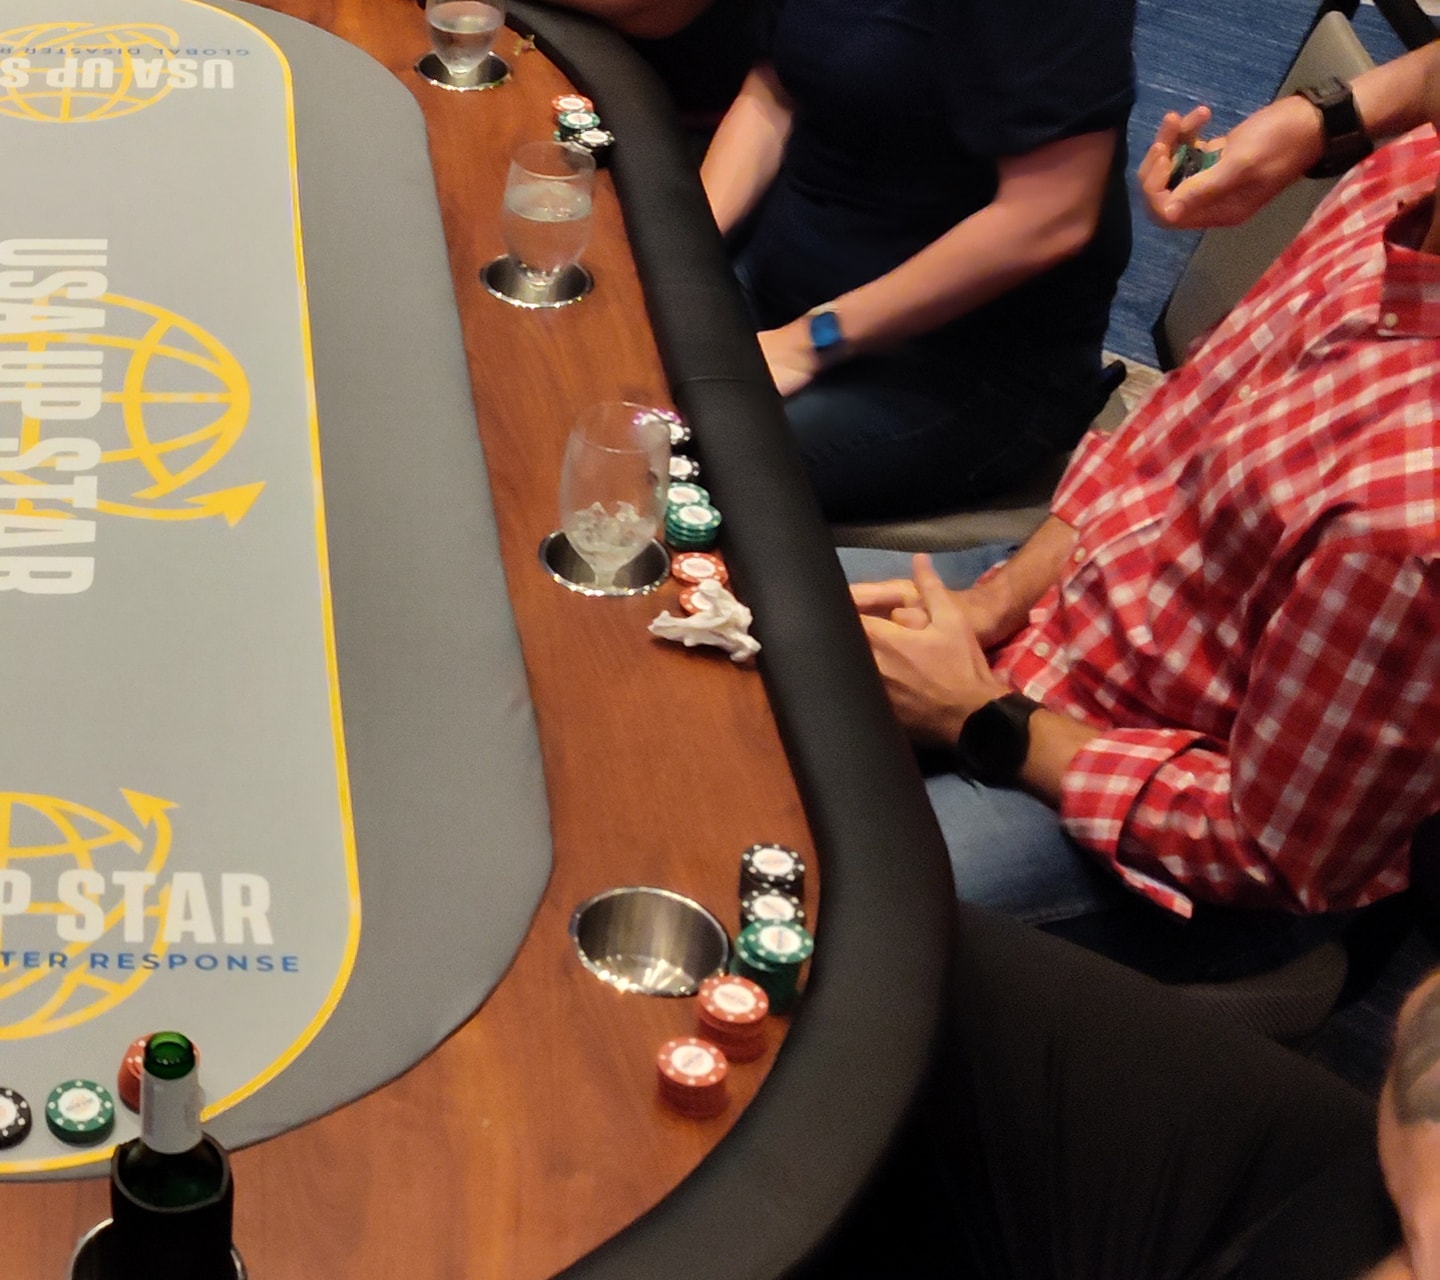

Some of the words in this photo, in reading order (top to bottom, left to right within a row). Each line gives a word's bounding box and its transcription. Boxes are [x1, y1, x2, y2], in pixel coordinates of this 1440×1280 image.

[154, 47, 251, 57] GLOBAL
[45, 57, 115, 89] UP
[132, 57, 235, 90] USA
[56, 869, 275, 946] STAR
[89, 952, 300, 973] RESPONSE
